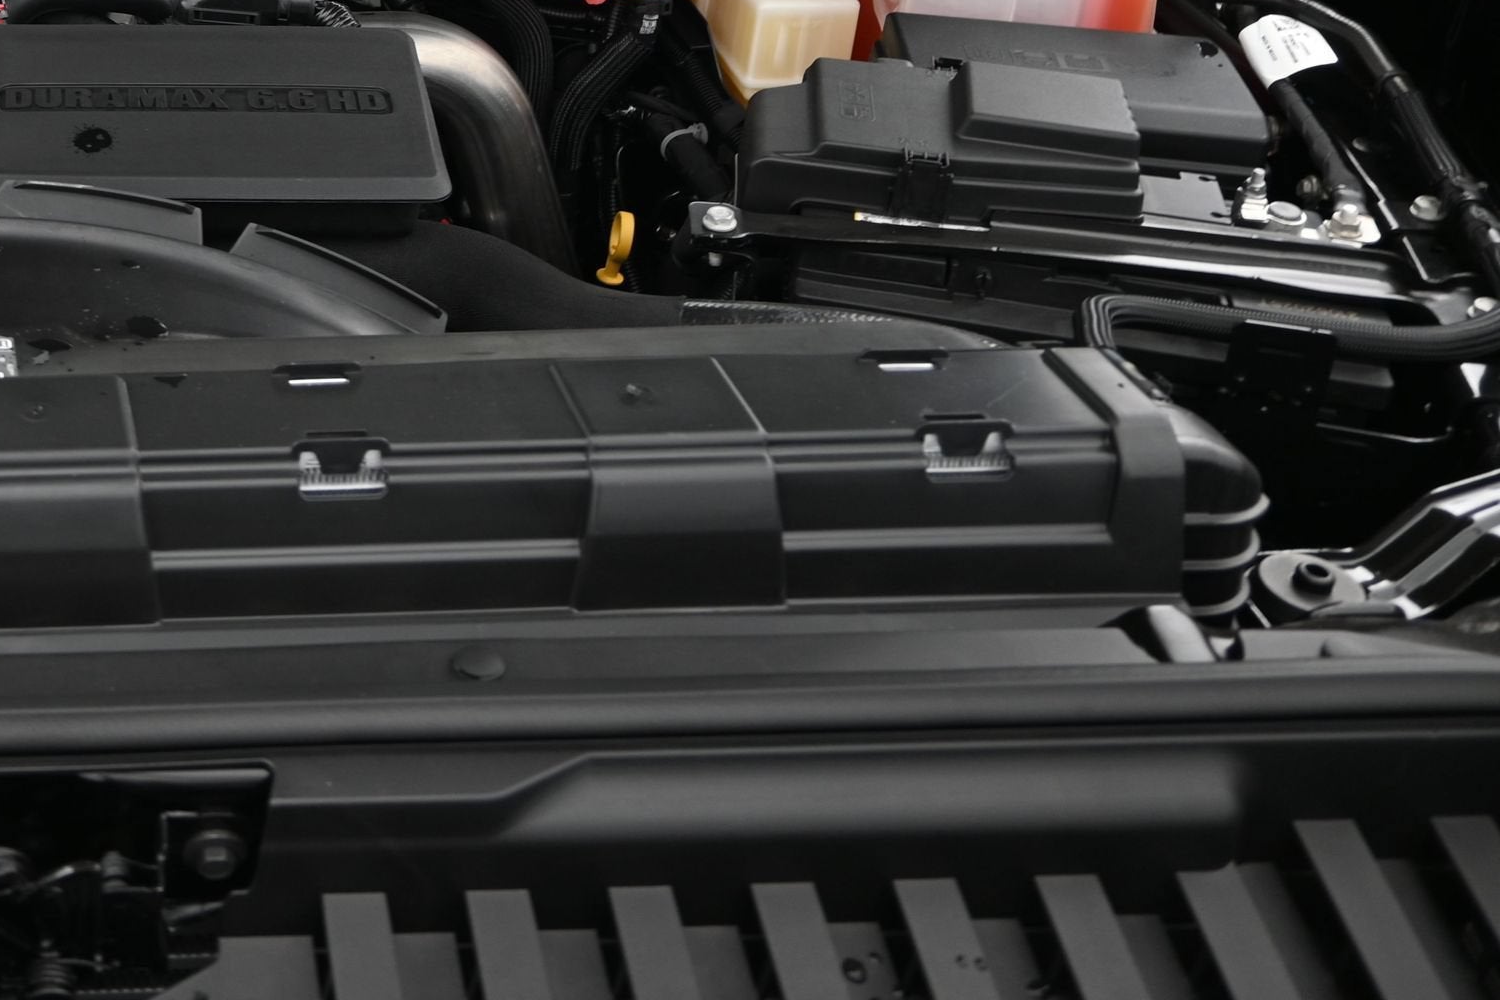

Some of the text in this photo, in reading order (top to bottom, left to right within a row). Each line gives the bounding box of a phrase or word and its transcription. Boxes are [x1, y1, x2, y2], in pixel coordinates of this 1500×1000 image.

[4, 87, 390, 114] DURAMAX 6.6 HD
